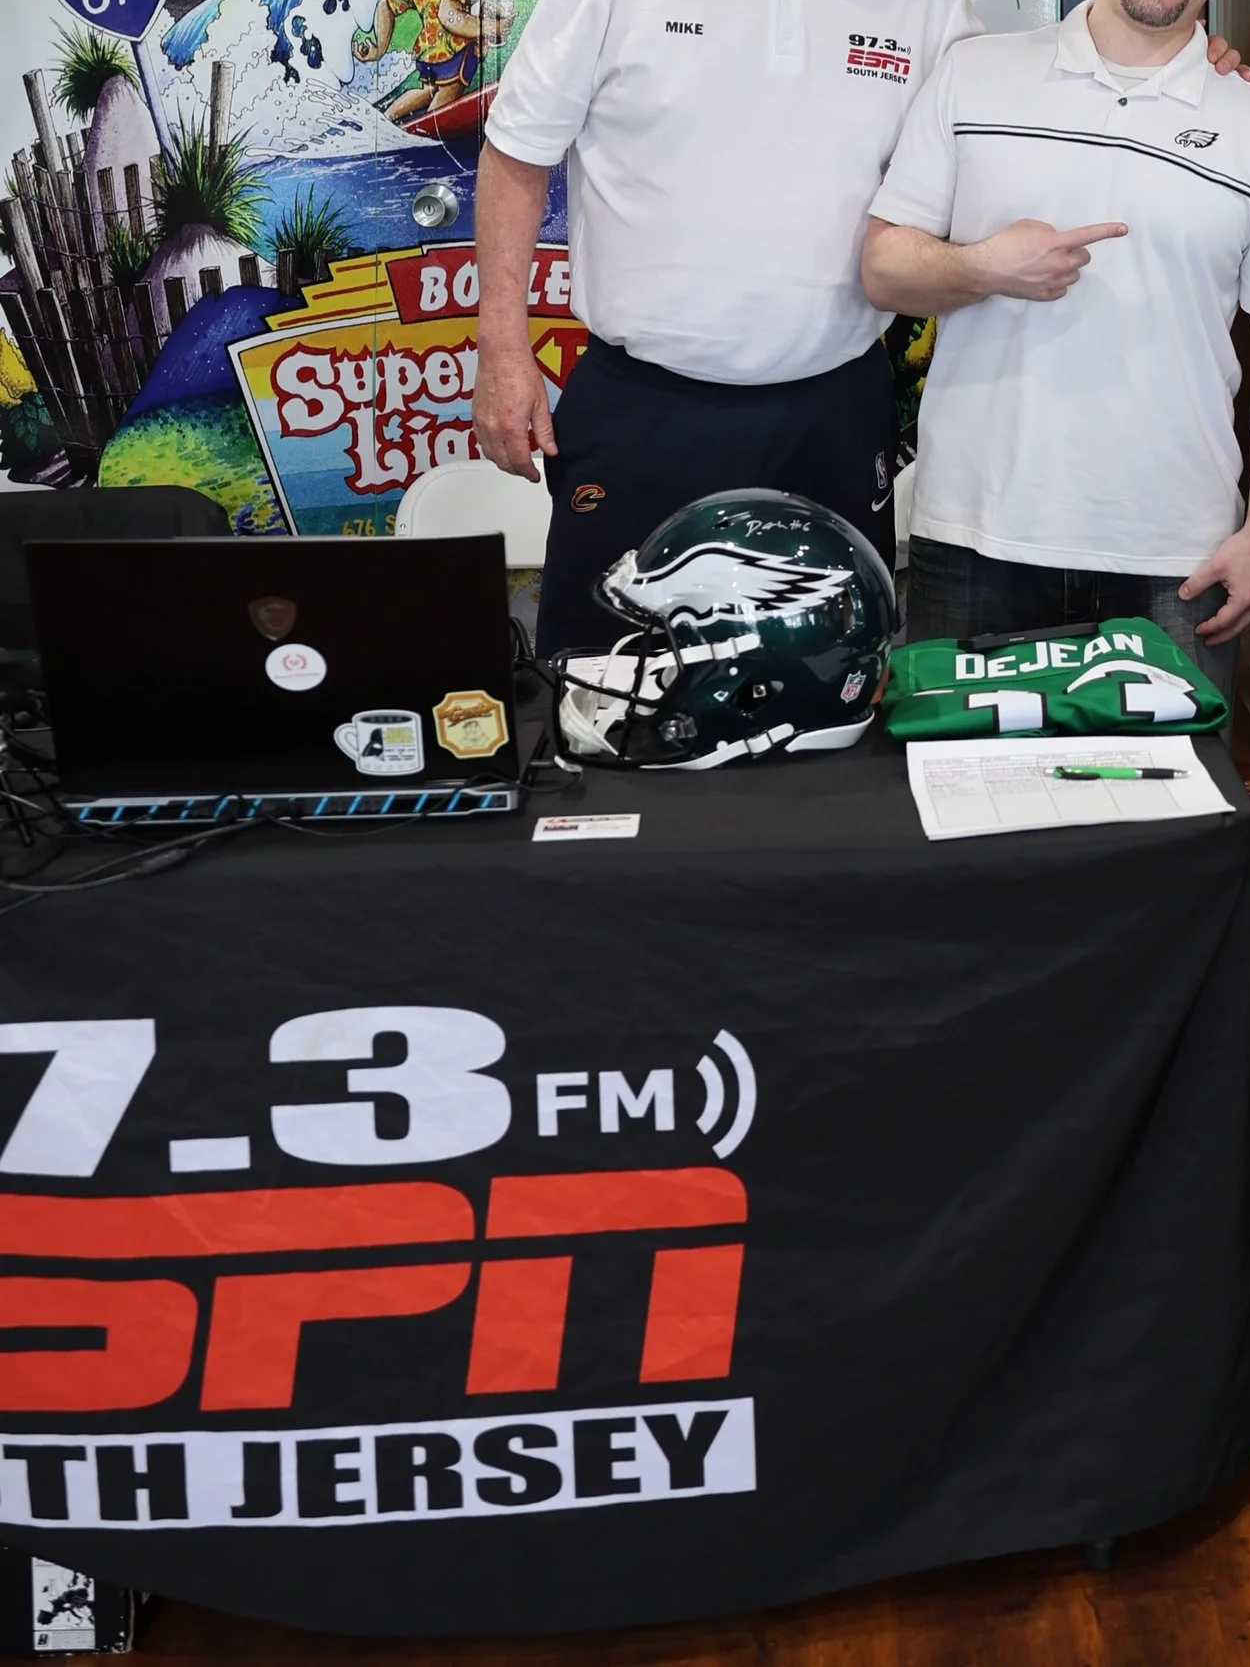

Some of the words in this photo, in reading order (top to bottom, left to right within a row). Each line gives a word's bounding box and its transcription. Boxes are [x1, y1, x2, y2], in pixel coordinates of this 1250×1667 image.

[665, 20, 704, 35] MIKE
[848, 33, 898, 52] 97.3
[847, 47, 911, 75] ESPN
[846, 66, 879, 78] SOUTH
[880, 71, 908, 85] JERSEY
[342, 518, 376, 537] 676
[385, 514, 396, 536] S
[0, 1006, 512, 1178] 7.3
[537, 1068, 676, 1137] FM
[0, 1167, 749, 1412] SPN
[0, 1444, 188, 1522] TH
[230, 1410, 730, 1521] JERSEY
